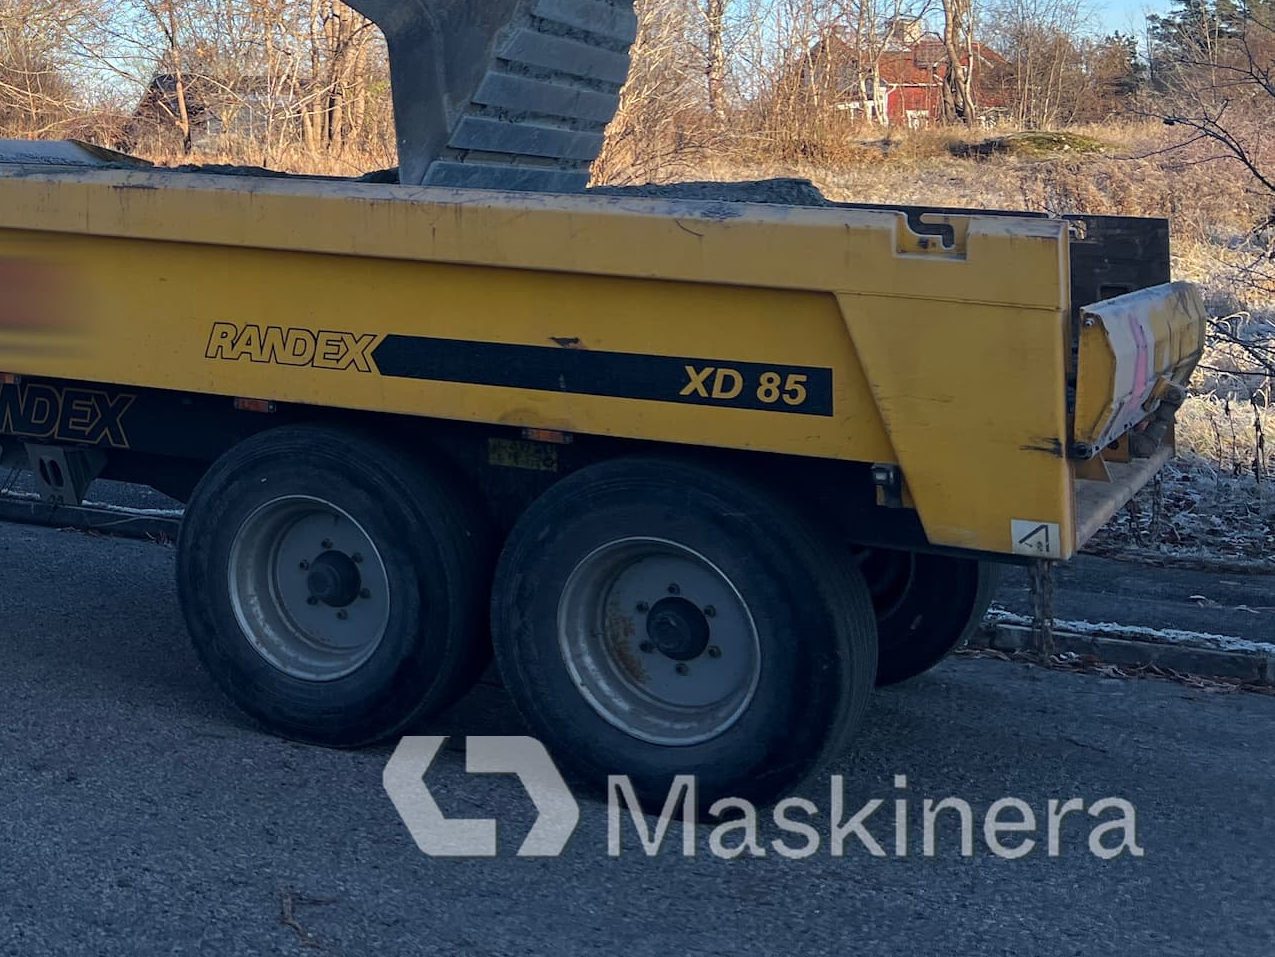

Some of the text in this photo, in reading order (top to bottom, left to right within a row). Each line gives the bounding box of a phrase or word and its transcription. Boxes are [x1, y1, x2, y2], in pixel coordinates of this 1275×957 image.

[205, 321, 378, 373] RANDEX
[679, 365, 808, 405] XD 85
